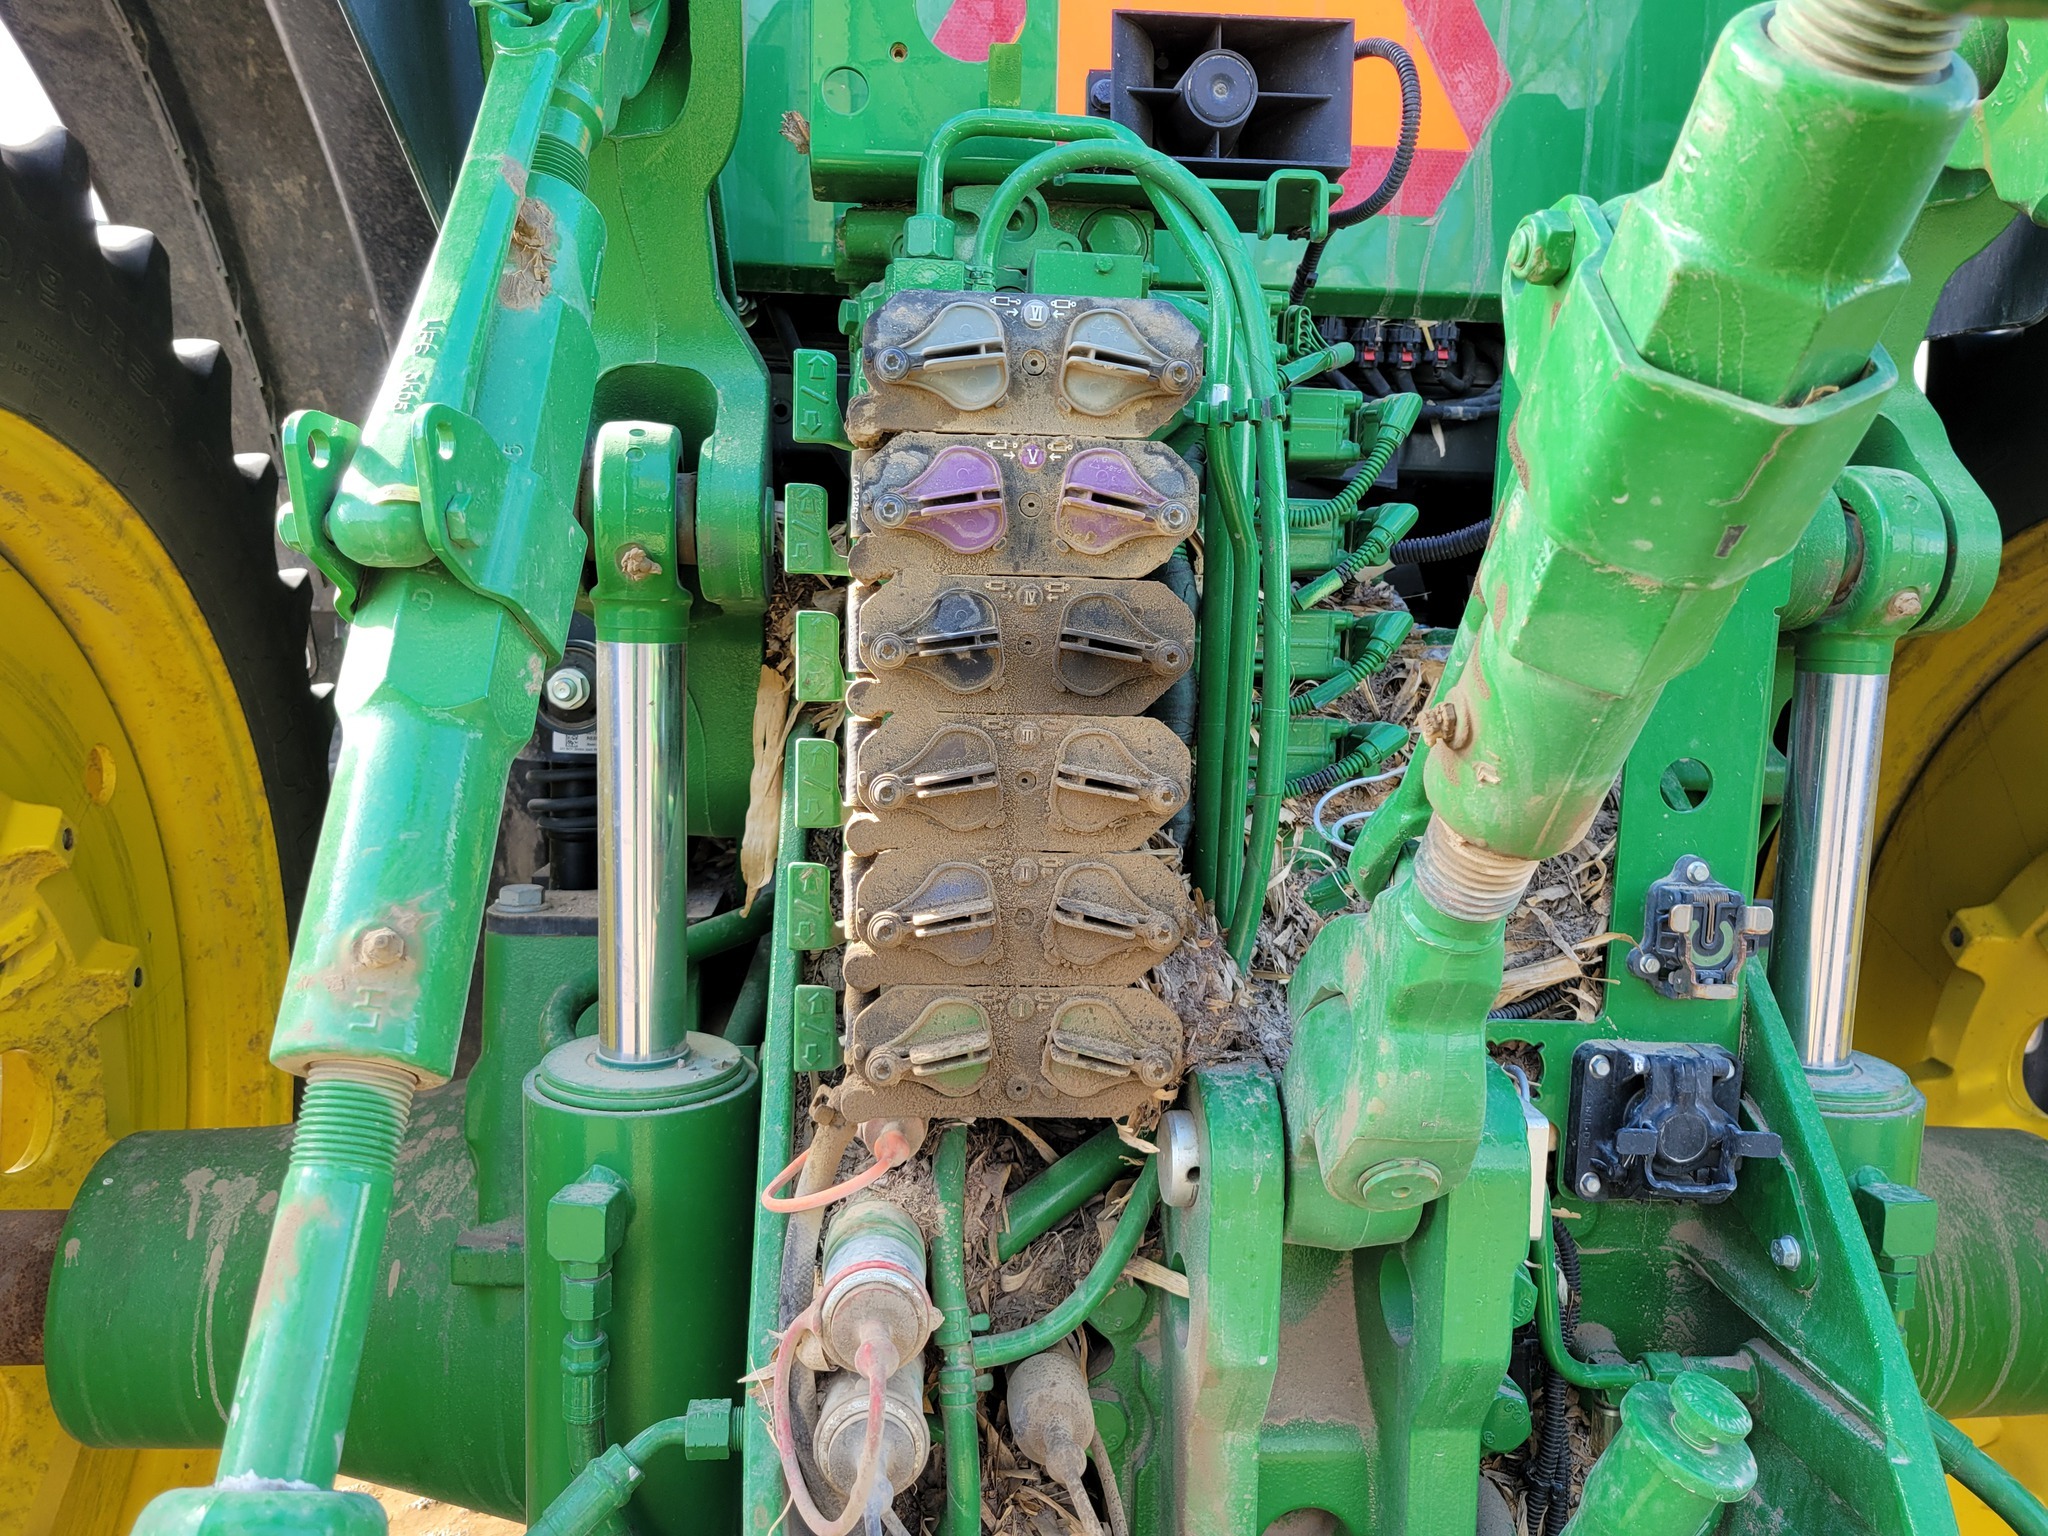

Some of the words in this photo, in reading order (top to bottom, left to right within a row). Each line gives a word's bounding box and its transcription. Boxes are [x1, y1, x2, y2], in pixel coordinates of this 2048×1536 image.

[1030, 305, 1043, 321] VI
[1027, 449, 1040, 465] V
[851, 473, 861, 521] TA22867
[1024, 589, 1037, 606] IV
